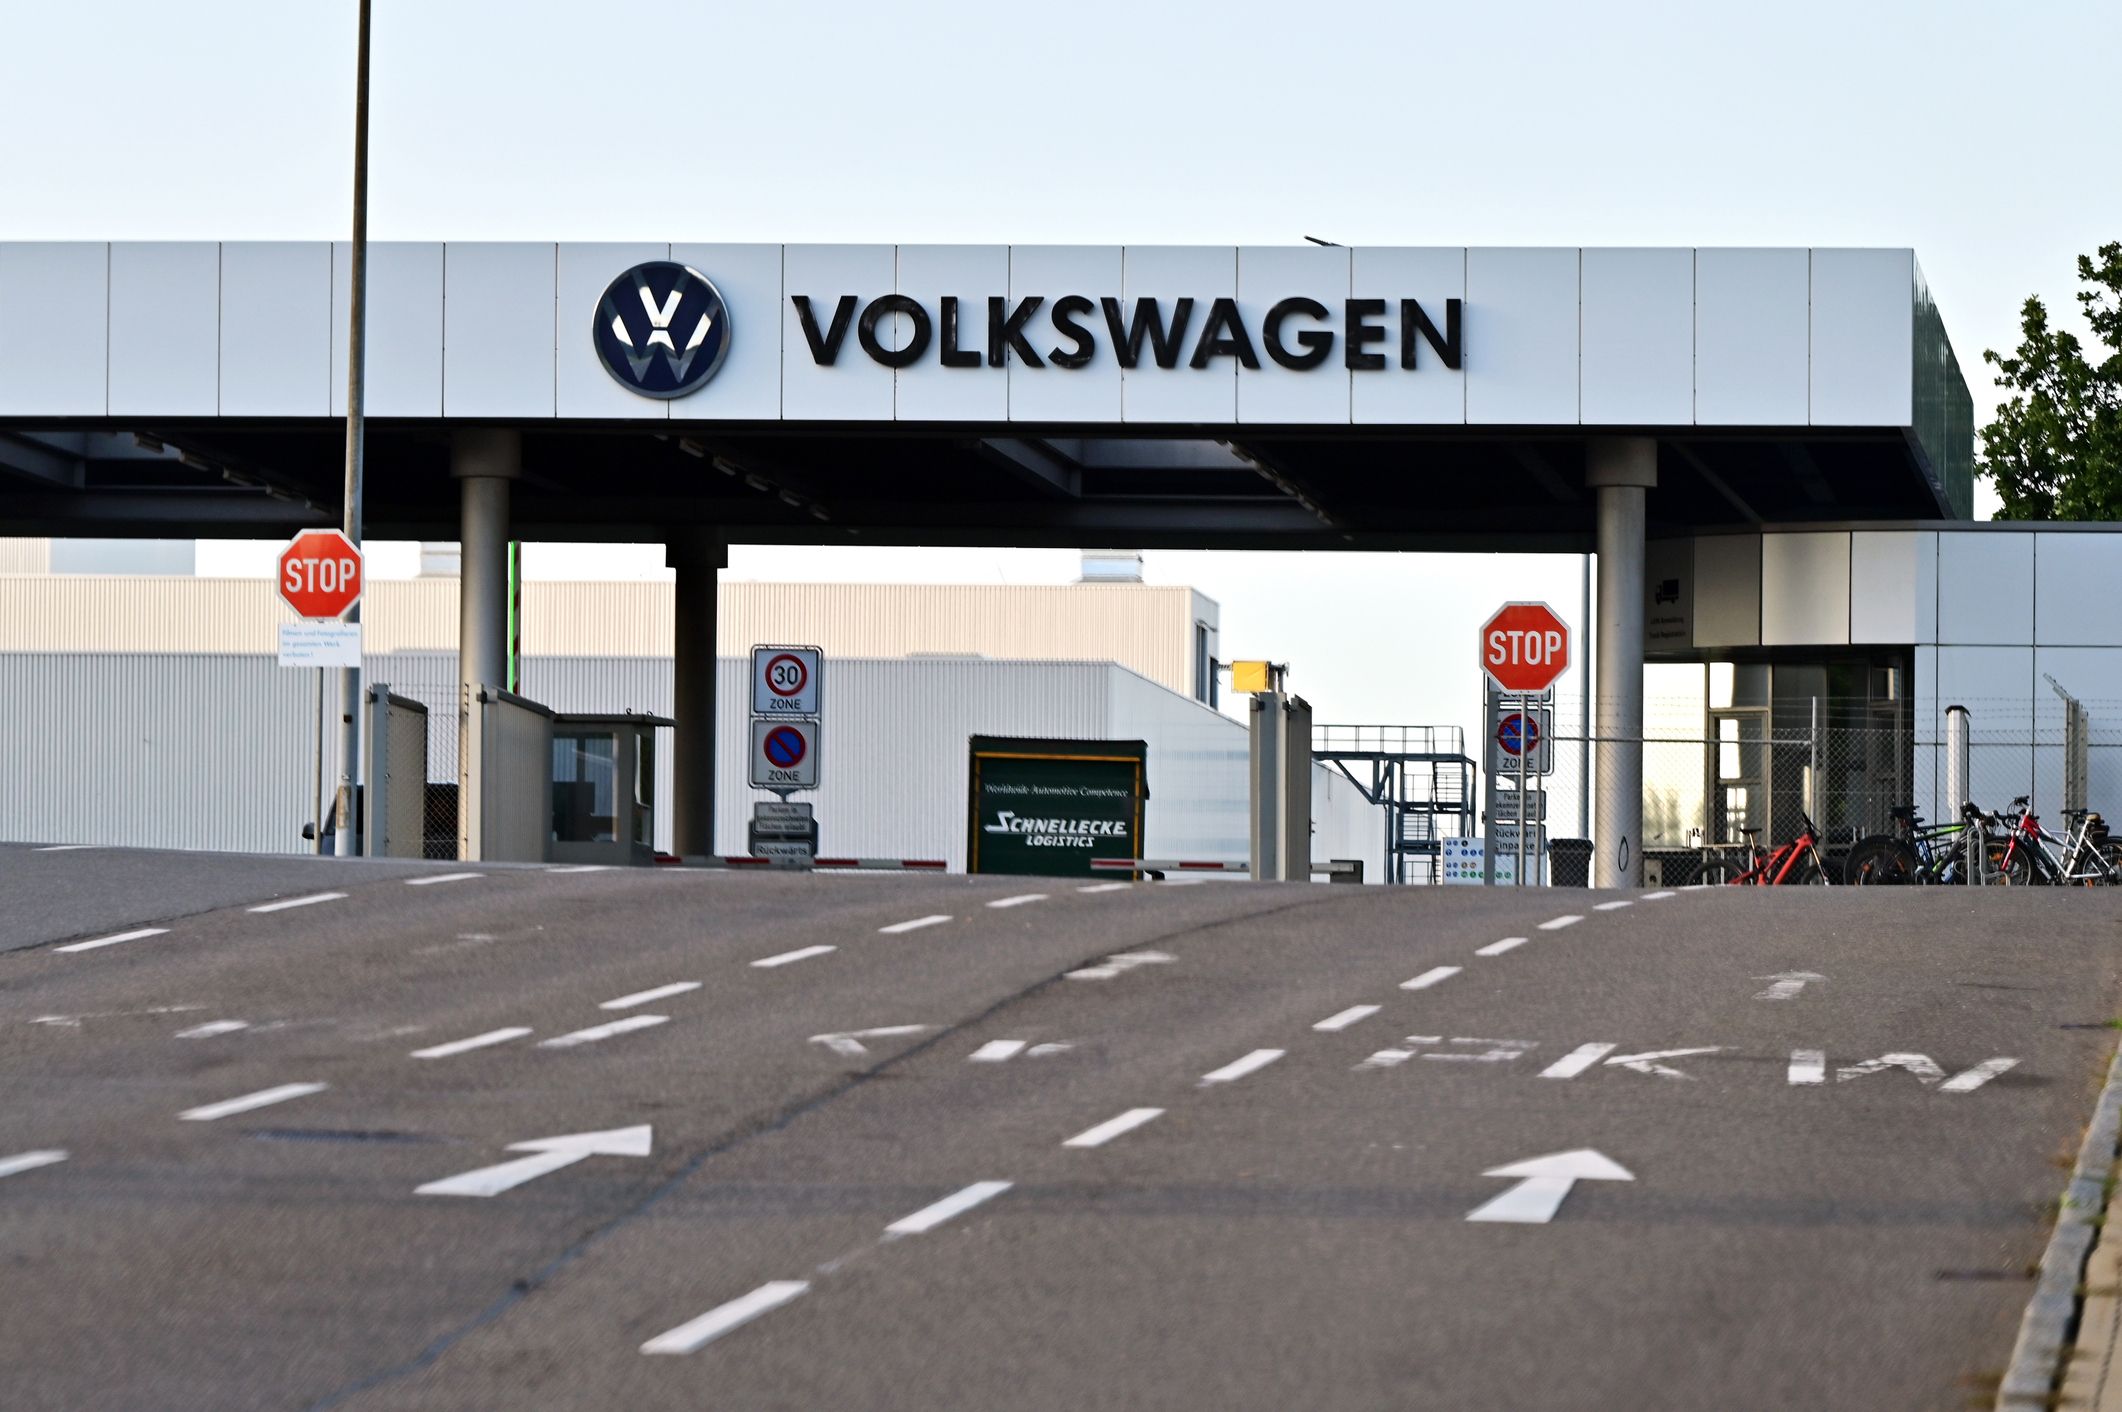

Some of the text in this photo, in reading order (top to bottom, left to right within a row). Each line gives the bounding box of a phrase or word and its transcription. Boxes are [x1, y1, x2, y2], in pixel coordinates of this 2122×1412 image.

[791, 294, 1462, 370] VOLKSWAGEN
[286, 558, 356, 593] STOP
[1489, 630, 1562, 665] STOP
[774, 665, 798, 685] 30
[770, 698, 801, 710] ZONE
[1503, 758, 1534, 769] ZOE
[768, 770, 800, 782] ZONE
[984, 810, 1128, 836] SCHNELLECKE
[1025, 834, 1095, 848] LOGISTICS
